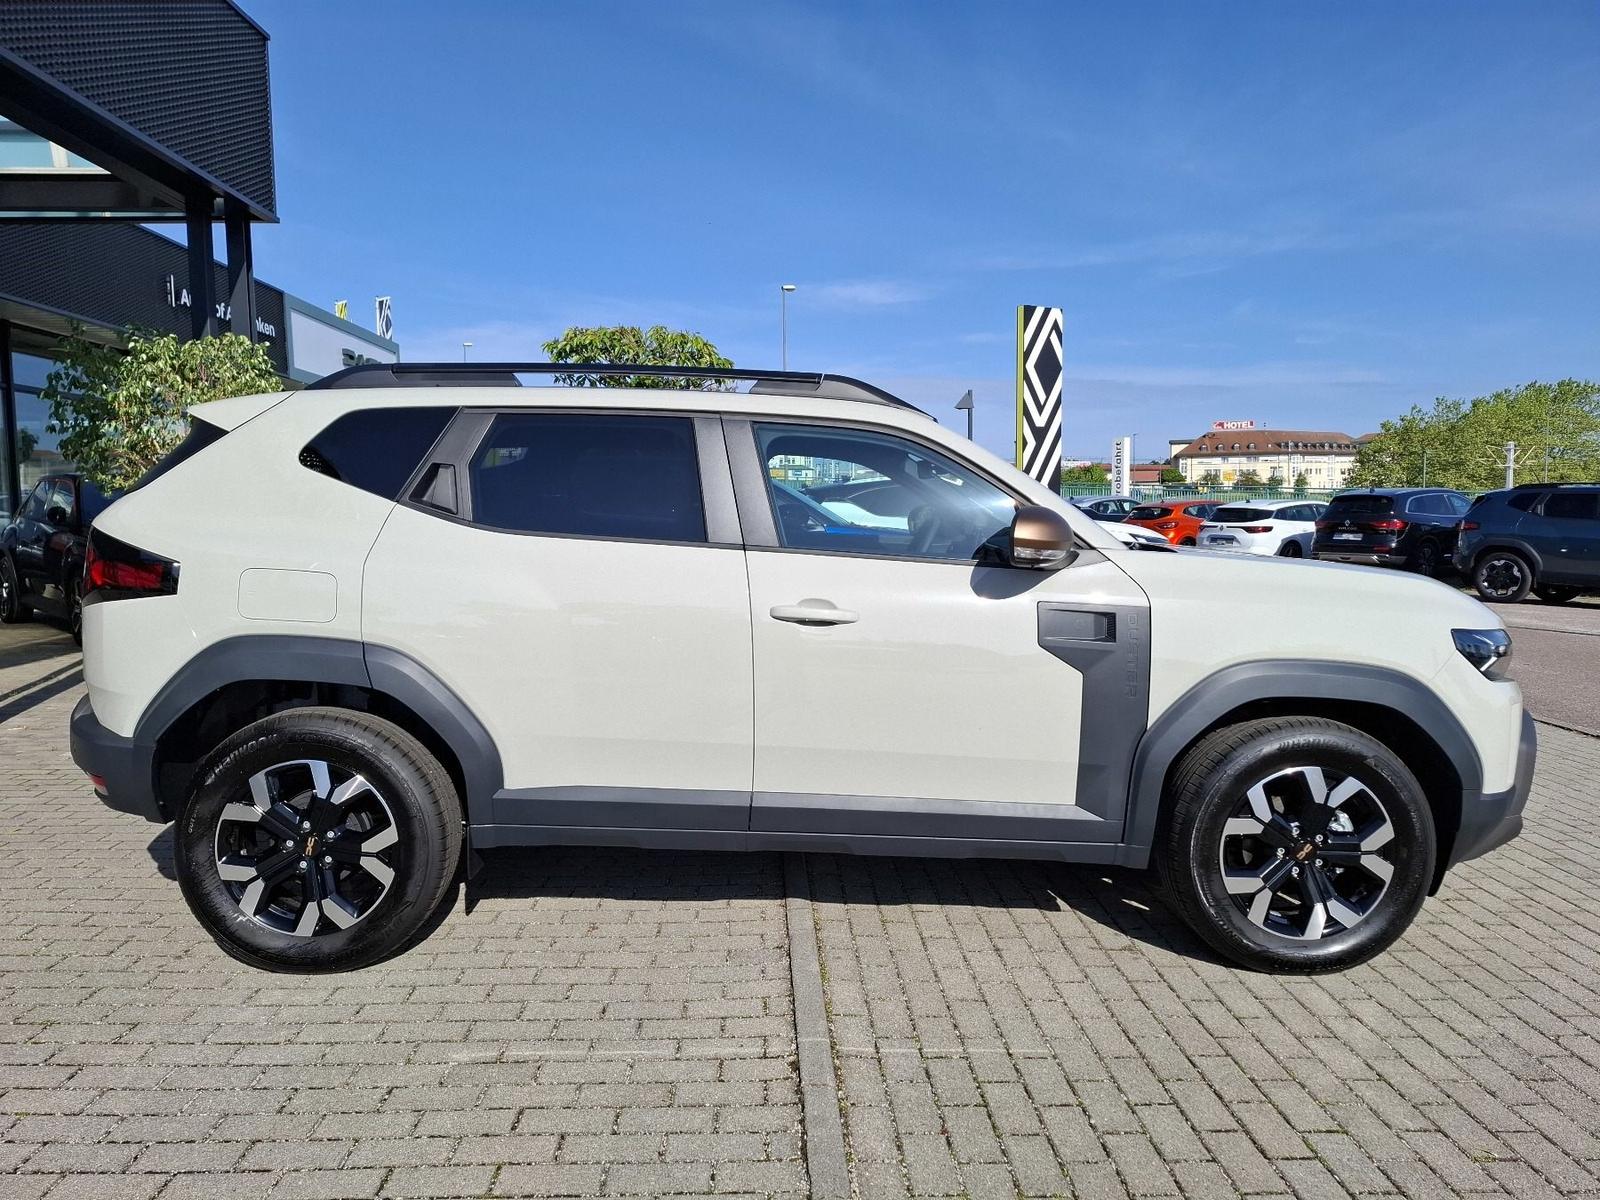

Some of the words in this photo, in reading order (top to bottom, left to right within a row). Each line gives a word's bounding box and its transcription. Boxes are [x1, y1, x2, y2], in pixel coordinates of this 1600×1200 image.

[1223, 420, 1254, 430] HOTEL
[1114, 441, 1122, 496] robefahrt
[1126, 613, 1139, 699] DUSTER
